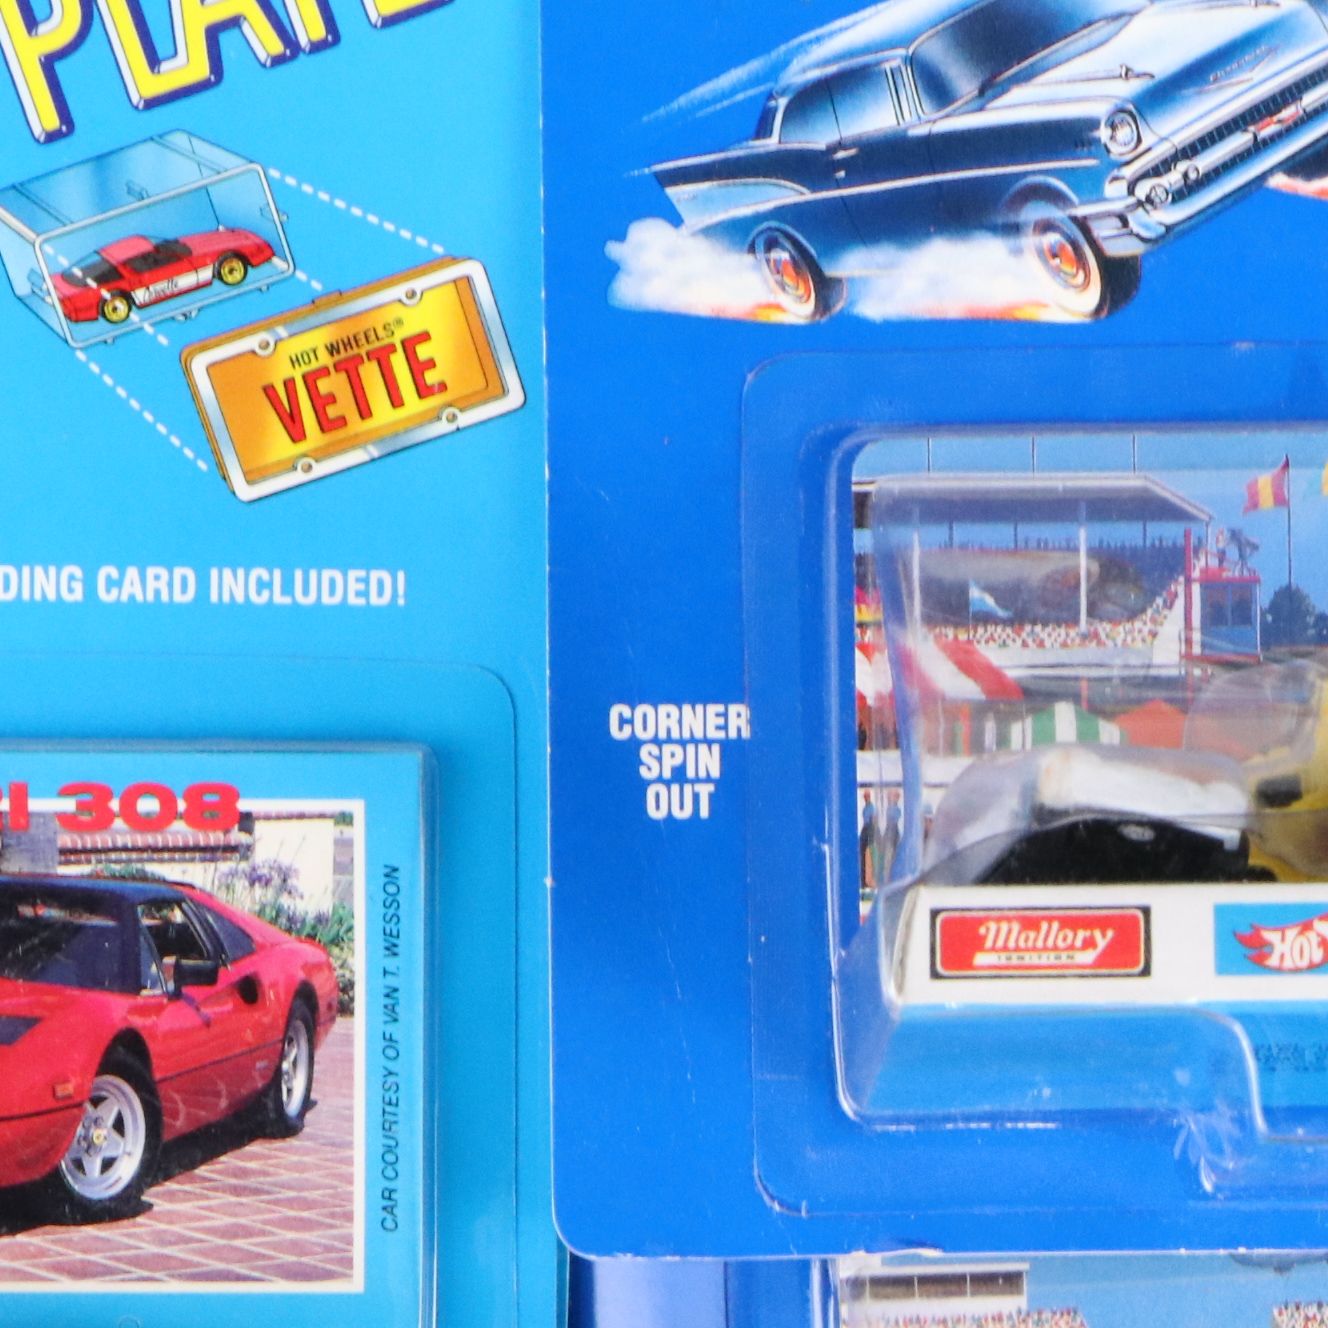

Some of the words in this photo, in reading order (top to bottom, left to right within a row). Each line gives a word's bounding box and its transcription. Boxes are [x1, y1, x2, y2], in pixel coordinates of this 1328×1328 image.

[289, 347, 320, 369] HOT
[262, 330, 448, 443] VETTE
[0, 564, 83, 602] DING
[97, 565, 196, 603] CARD
[210, 567, 405, 606] INCLUDED!
[610, 704, 750, 740] CORNER
[639, 744, 720, 779] SPIN
[56, 781, 241, 833] 308
[646, 783, 714, 819] OUT
[383, 864, 401, 959] WESSON
[978, 919, 1114, 951] Mallory
[383, 966, 400, 984] T.
[383, 985, 400, 1025] VAN
[382, 1030, 400, 1061] OF
[381, 1065, 400, 1181] COURTESY
[381, 1187, 399, 1232] CAR
